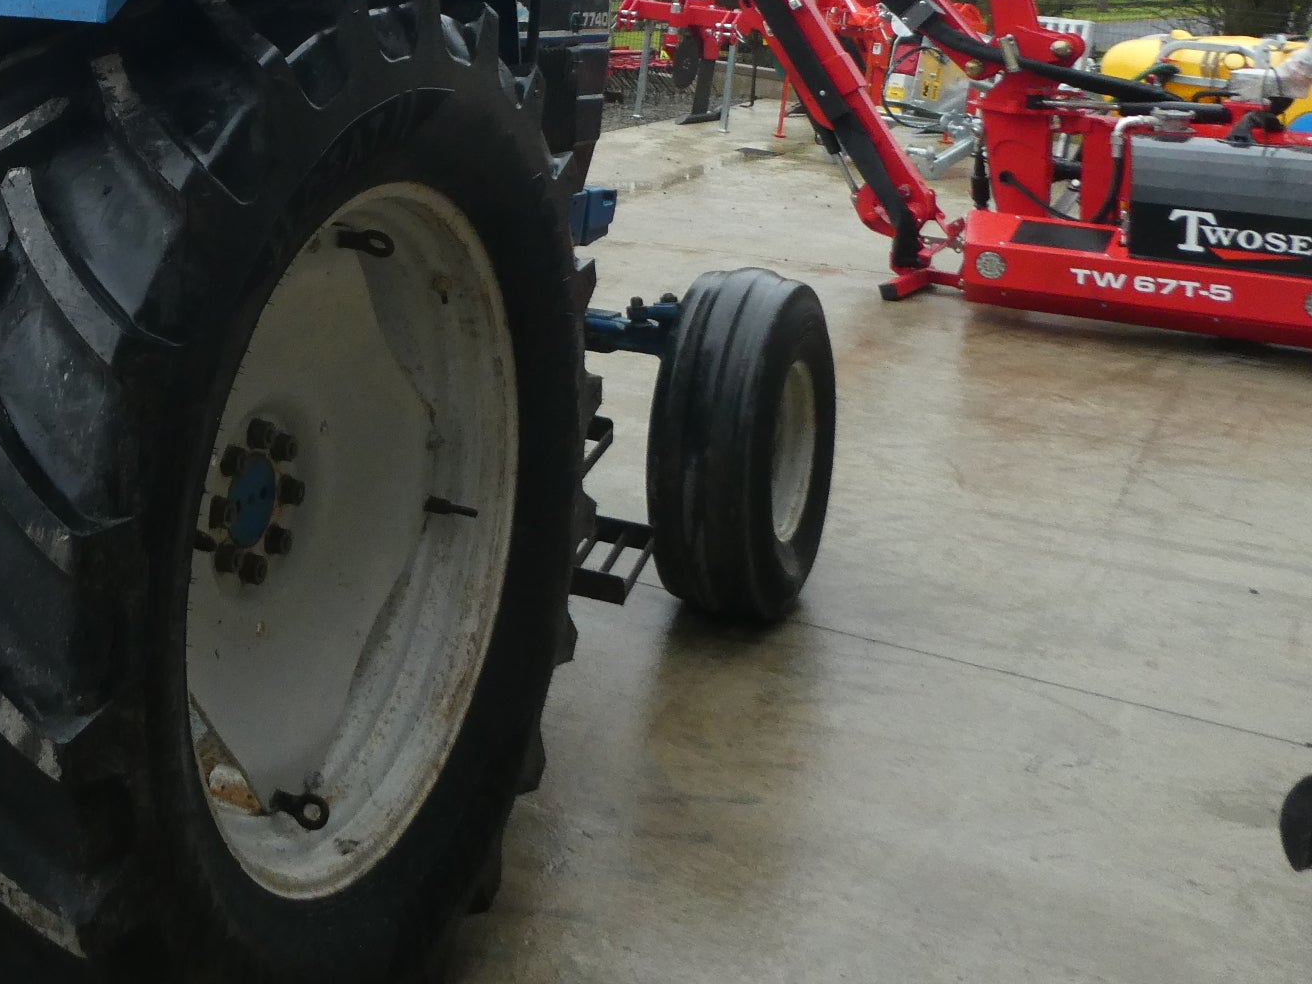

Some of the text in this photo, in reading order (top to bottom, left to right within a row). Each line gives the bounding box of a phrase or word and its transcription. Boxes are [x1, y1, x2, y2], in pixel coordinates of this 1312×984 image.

[582, 12, 608, 27] 7740
[1070, 268, 1232, 301] TW 67T-5
